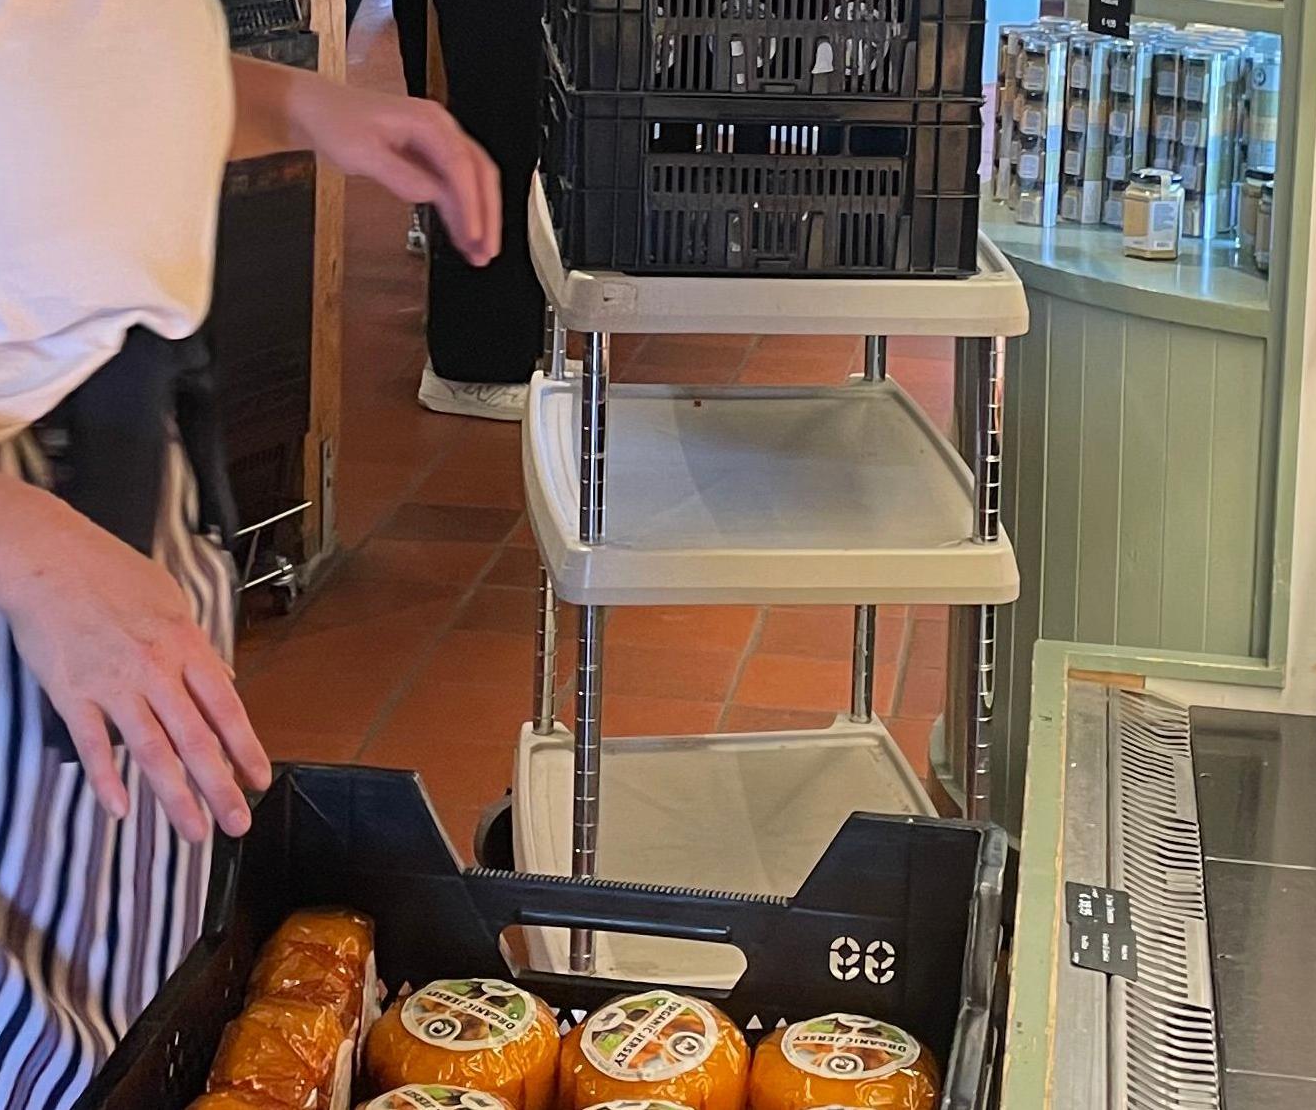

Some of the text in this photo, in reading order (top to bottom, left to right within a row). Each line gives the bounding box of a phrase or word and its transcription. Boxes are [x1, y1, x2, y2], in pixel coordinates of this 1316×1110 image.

[426, 990, 515, 1030] ORGANIC JERSEY
[614, 1002, 682, 1067] ORGANIC JERSEY
[793, 1035, 907, 1053] ORGANIC JERSEY
